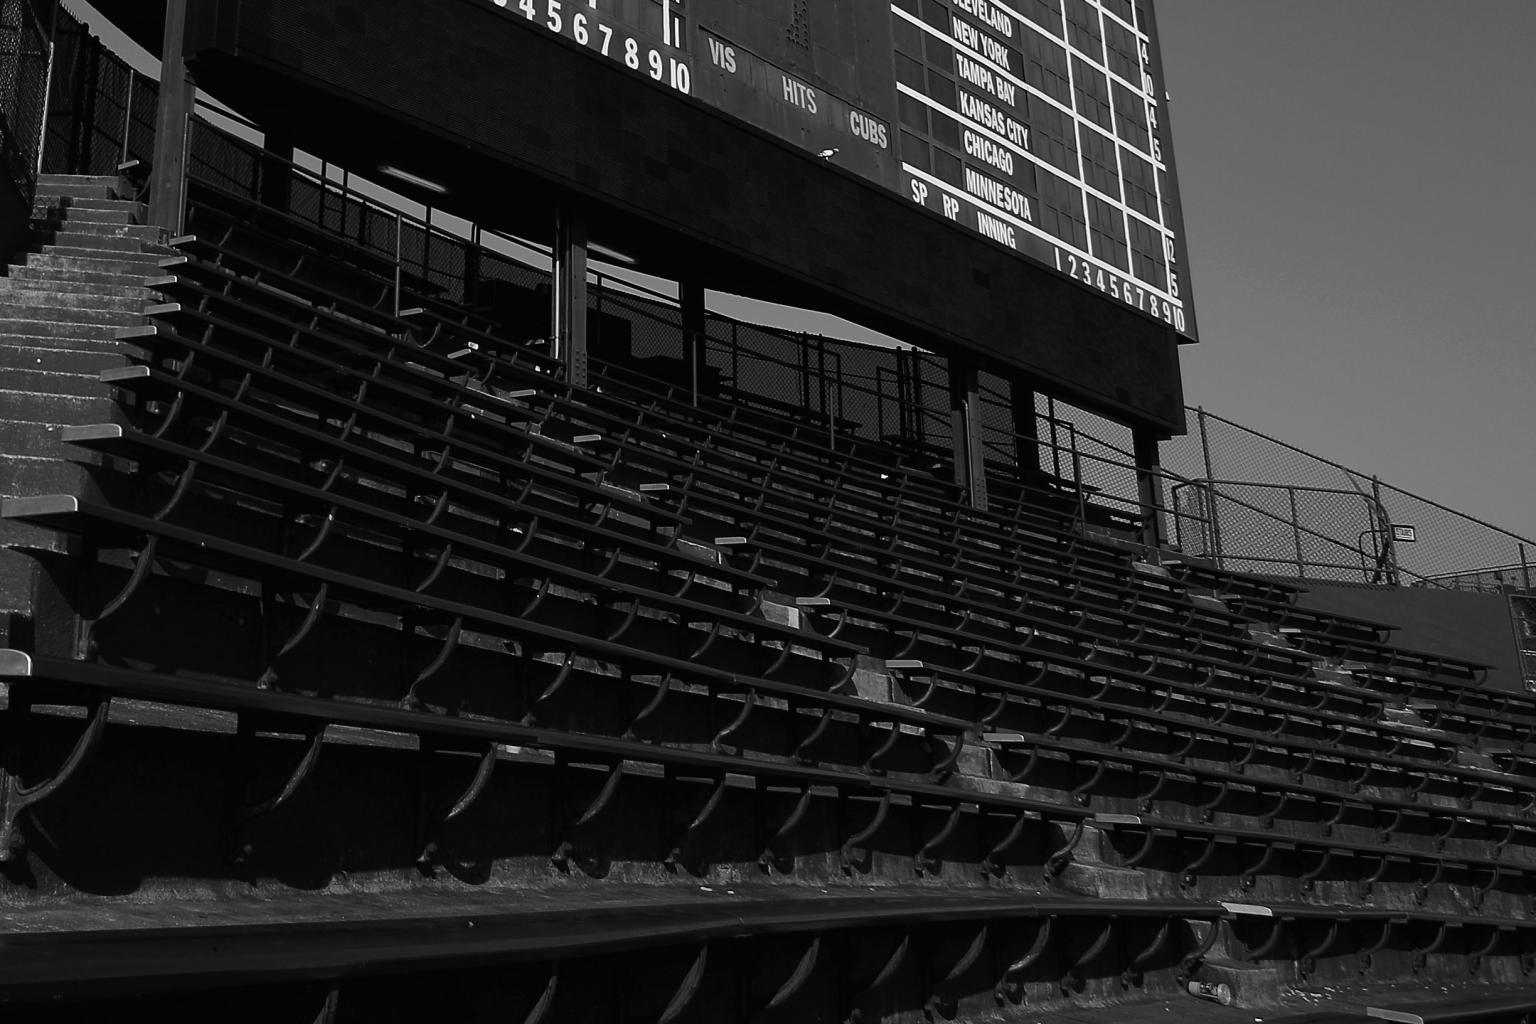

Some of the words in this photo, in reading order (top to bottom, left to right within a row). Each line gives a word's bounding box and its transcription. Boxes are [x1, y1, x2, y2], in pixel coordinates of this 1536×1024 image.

[573, 13, 588, 45] 6
[598, 23, 613, 56] 7
[624, 37, 639, 70] 8
[648, 49, 662, 81] 9
[670, 57, 690, 94] 10
[708, 37, 737, 74] VIS
[952, 16, 978, 51] NEW
[980, 32, 1011, 71] YORK
[1142, 42, 1149, 65] 4
[782, 75, 817, 114] HITS
[956, 53, 996, 96] TAMPA
[995, 76, 1015, 107] BAY
[849, 110, 888, 150] CUBS
[959, 90, 1006, 136] KANSAS
[1006, 118, 1029, 150] CITY
[1150, 106, 1157, 129] 4
[964, 130, 1014, 176] CHICAGO
[1153, 137, 1162, 162] 5
[965, 167, 1033, 222] MINNESOTA
[911, 178, 928, 207] SP
[942, 193, 959, 222] RP
[976, 211, 1017, 249] INNING
[1054, 246, 1062, 271] 1
[1068, 254, 1078, 280] 2
[1081, 261, 1092, 285] 3
[1096, 269, 1105, 292] 4
[1109, 274, 1119, 299] 5
[1124, 281, 1132, 305] 6
[1136, 287, 1144, 311] 7
[1149, 294, 1159, 318] 8
[1162, 301, 1171, 325] 9
[1172, 306, 1185, 332] 10
[1170, 272, 1178, 297] 5
